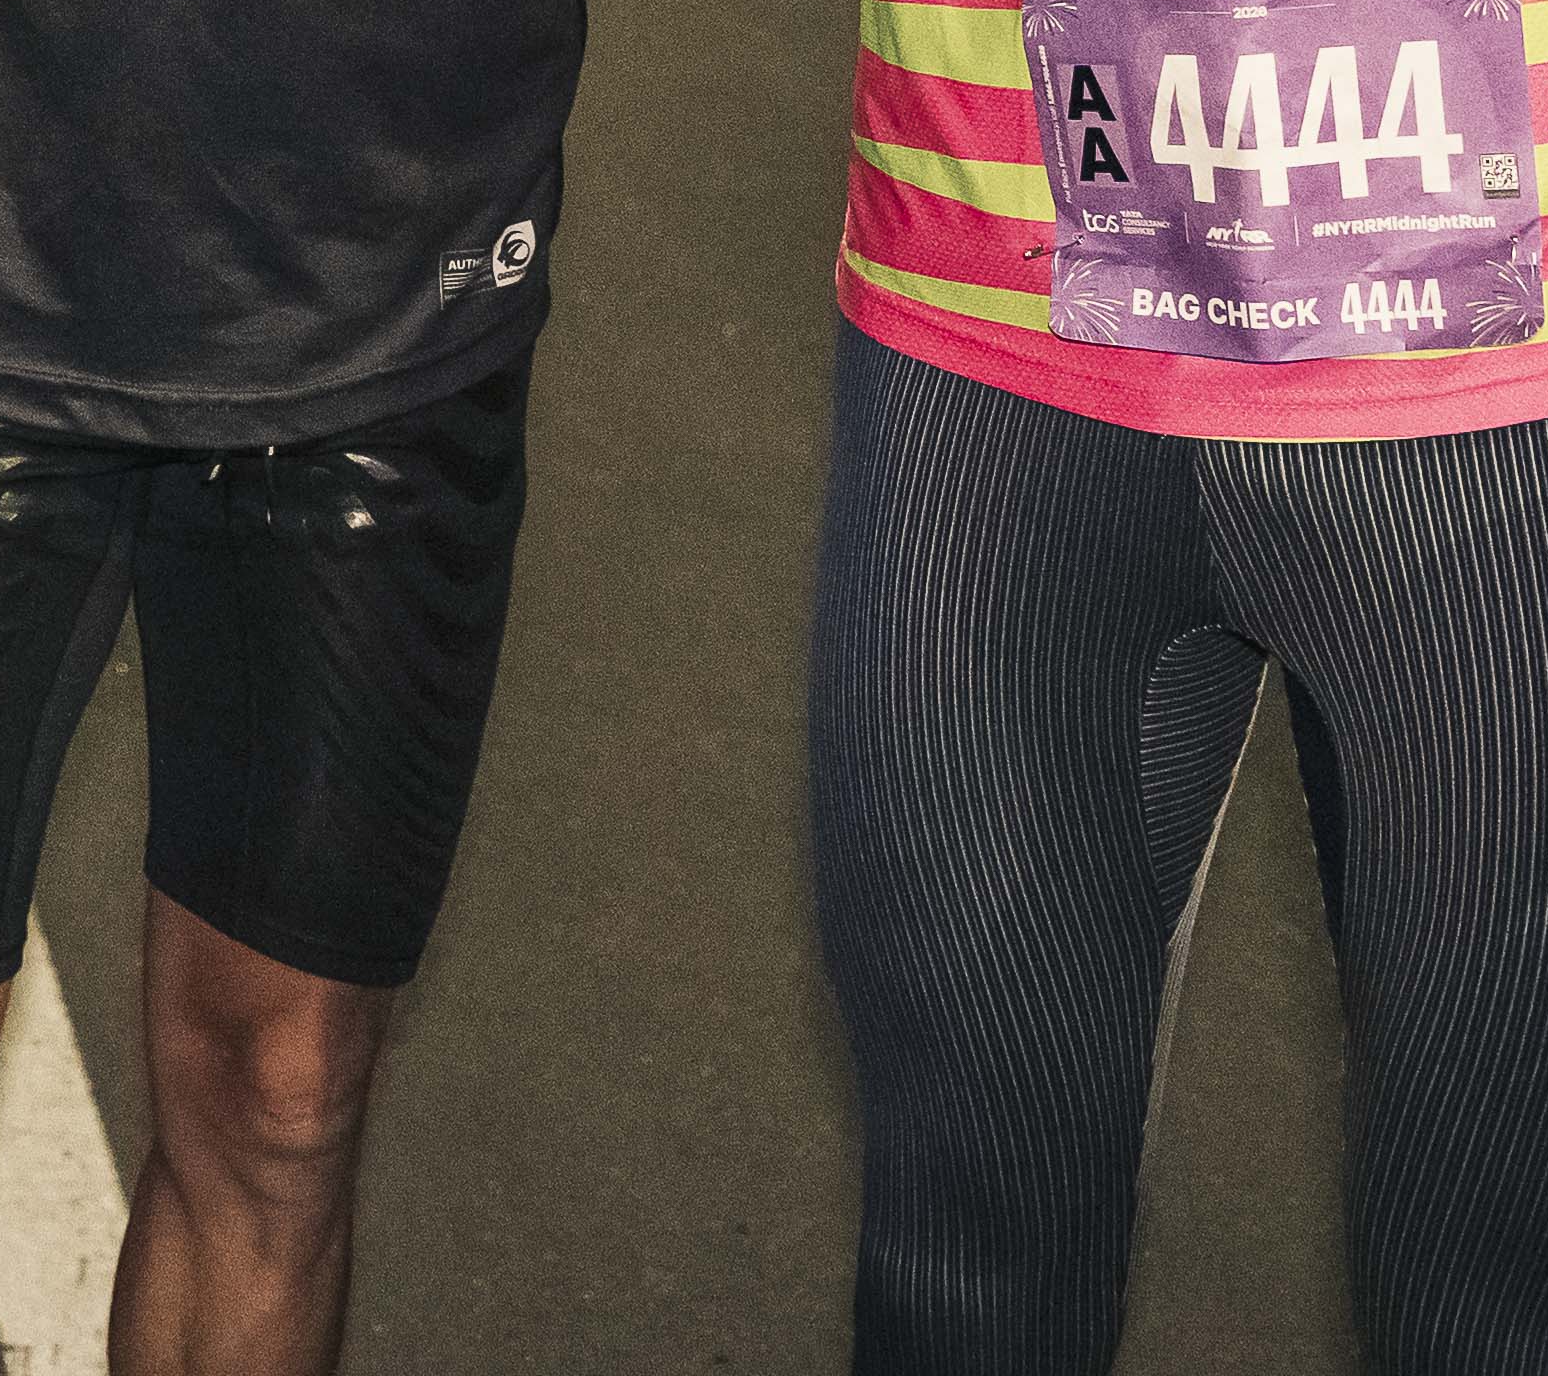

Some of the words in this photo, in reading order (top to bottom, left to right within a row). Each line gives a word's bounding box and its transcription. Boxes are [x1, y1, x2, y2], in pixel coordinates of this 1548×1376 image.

[1151, 40, 1463, 208] 4444
[1082, 208, 1120, 234] tcs
[1311, 213, 1496, 238] #NYRRMidnightRun
[1132, 288, 1200, 321] BAG
[1205, 296, 1320, 329] CHECK
[1339, 278, 1447, 335] 4444
